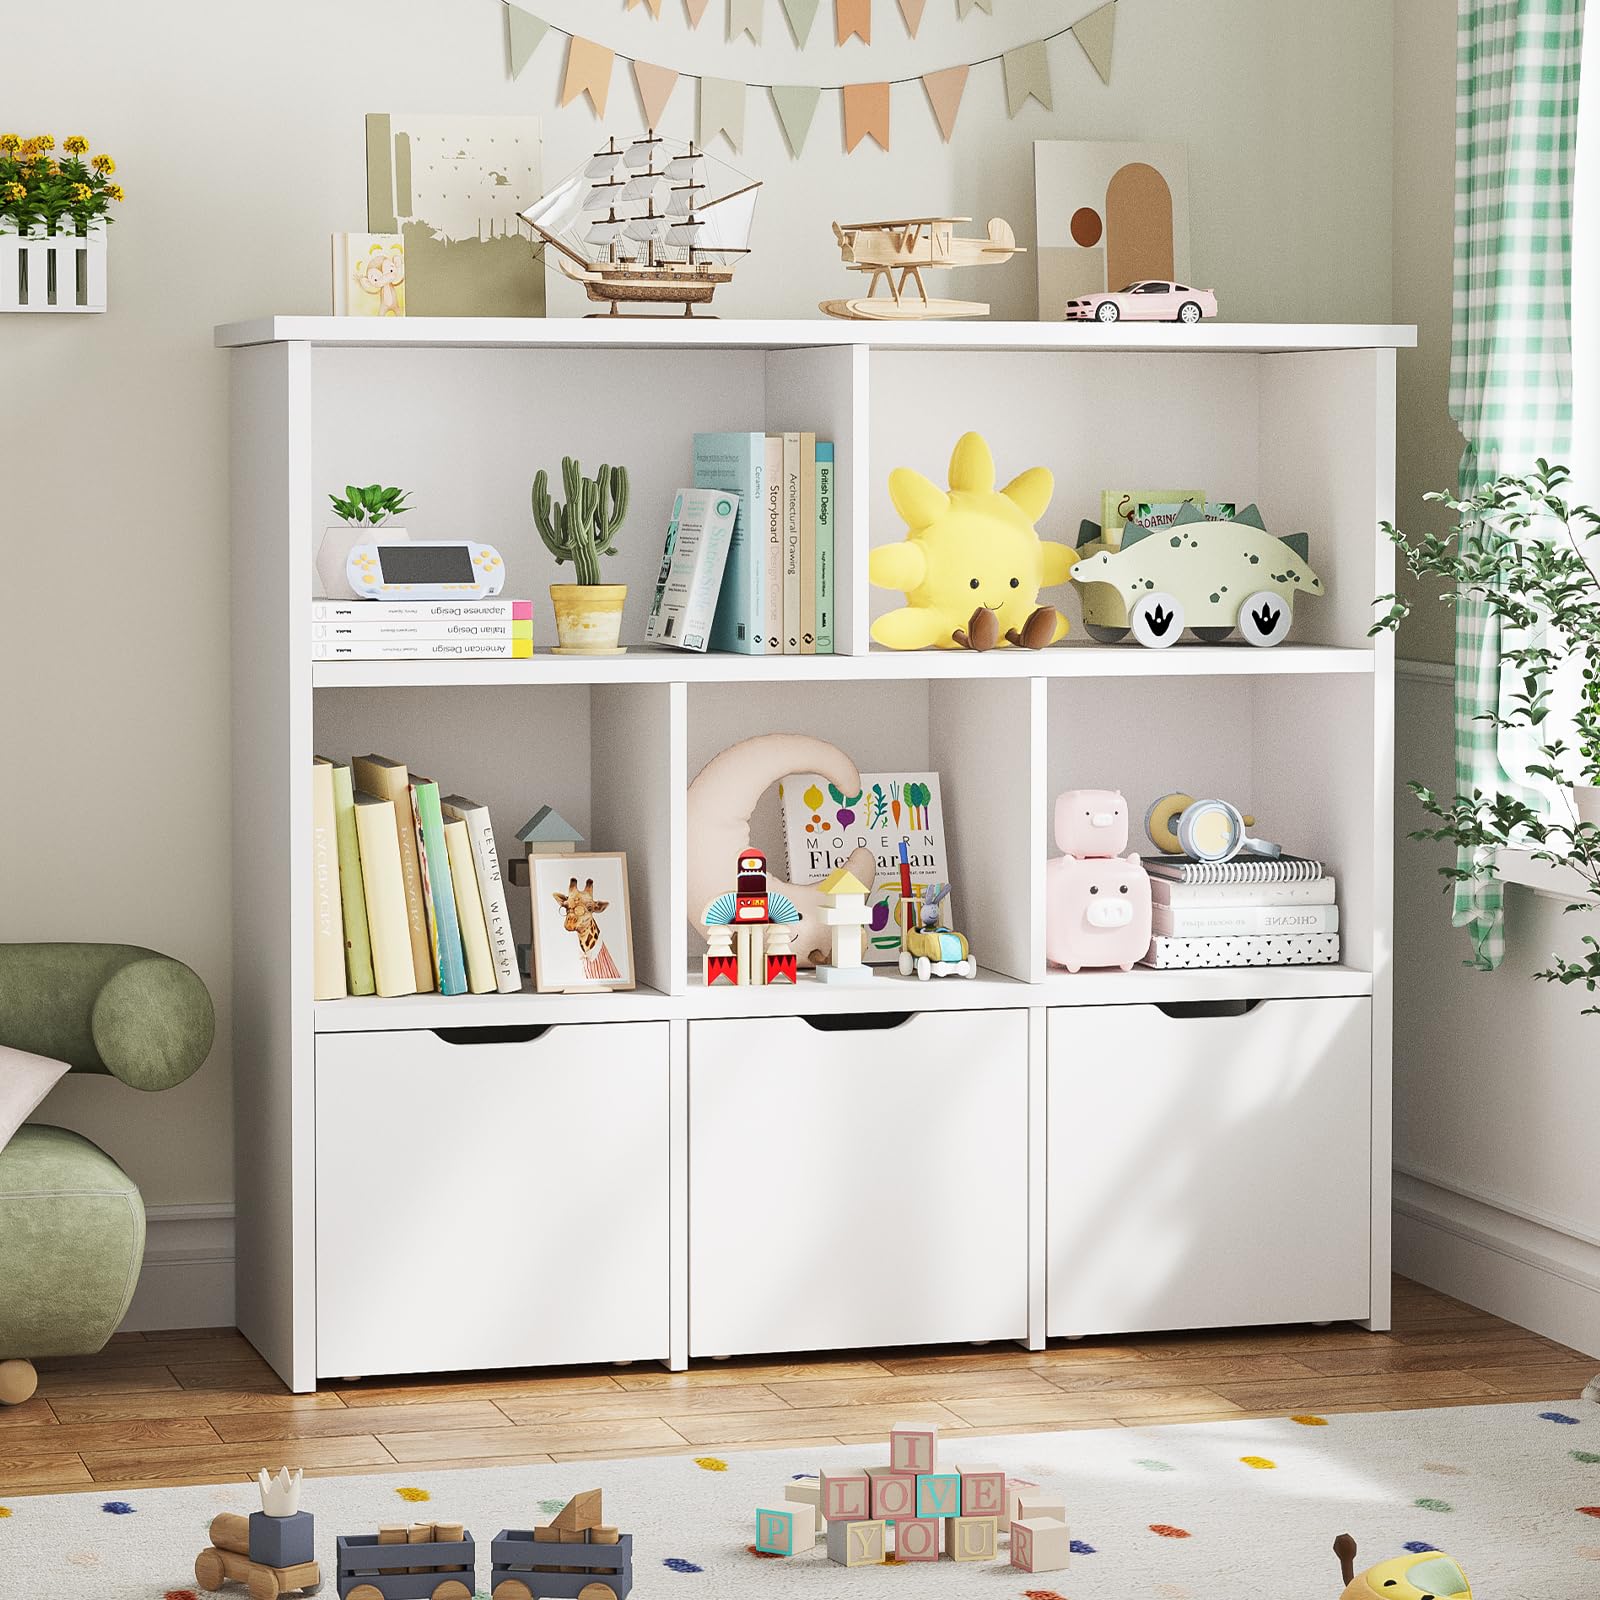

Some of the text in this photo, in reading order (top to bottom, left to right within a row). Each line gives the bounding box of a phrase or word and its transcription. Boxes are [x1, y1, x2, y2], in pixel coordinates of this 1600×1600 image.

[755, 466, 763, 499] Ceramics
[820, 468, 829, 526] British Design
[769, 485, 780, 543] Storyboard
[788, 473, 798, 575] Architectural Drawing
[768, 546, 779, 580] Design
[430, 607, 506, 616] Japanese Design
[769, 583, 779, 620] Course
[447, 627, 478, 635] Design
[432, 645, 462, 654] Design
[806, 835, 934, 849] MODERN
[809, 850, 936, 870] Flearan
[903, 1437, 921, 1469] I
[835, 1478, 997, 1515] LOVE
